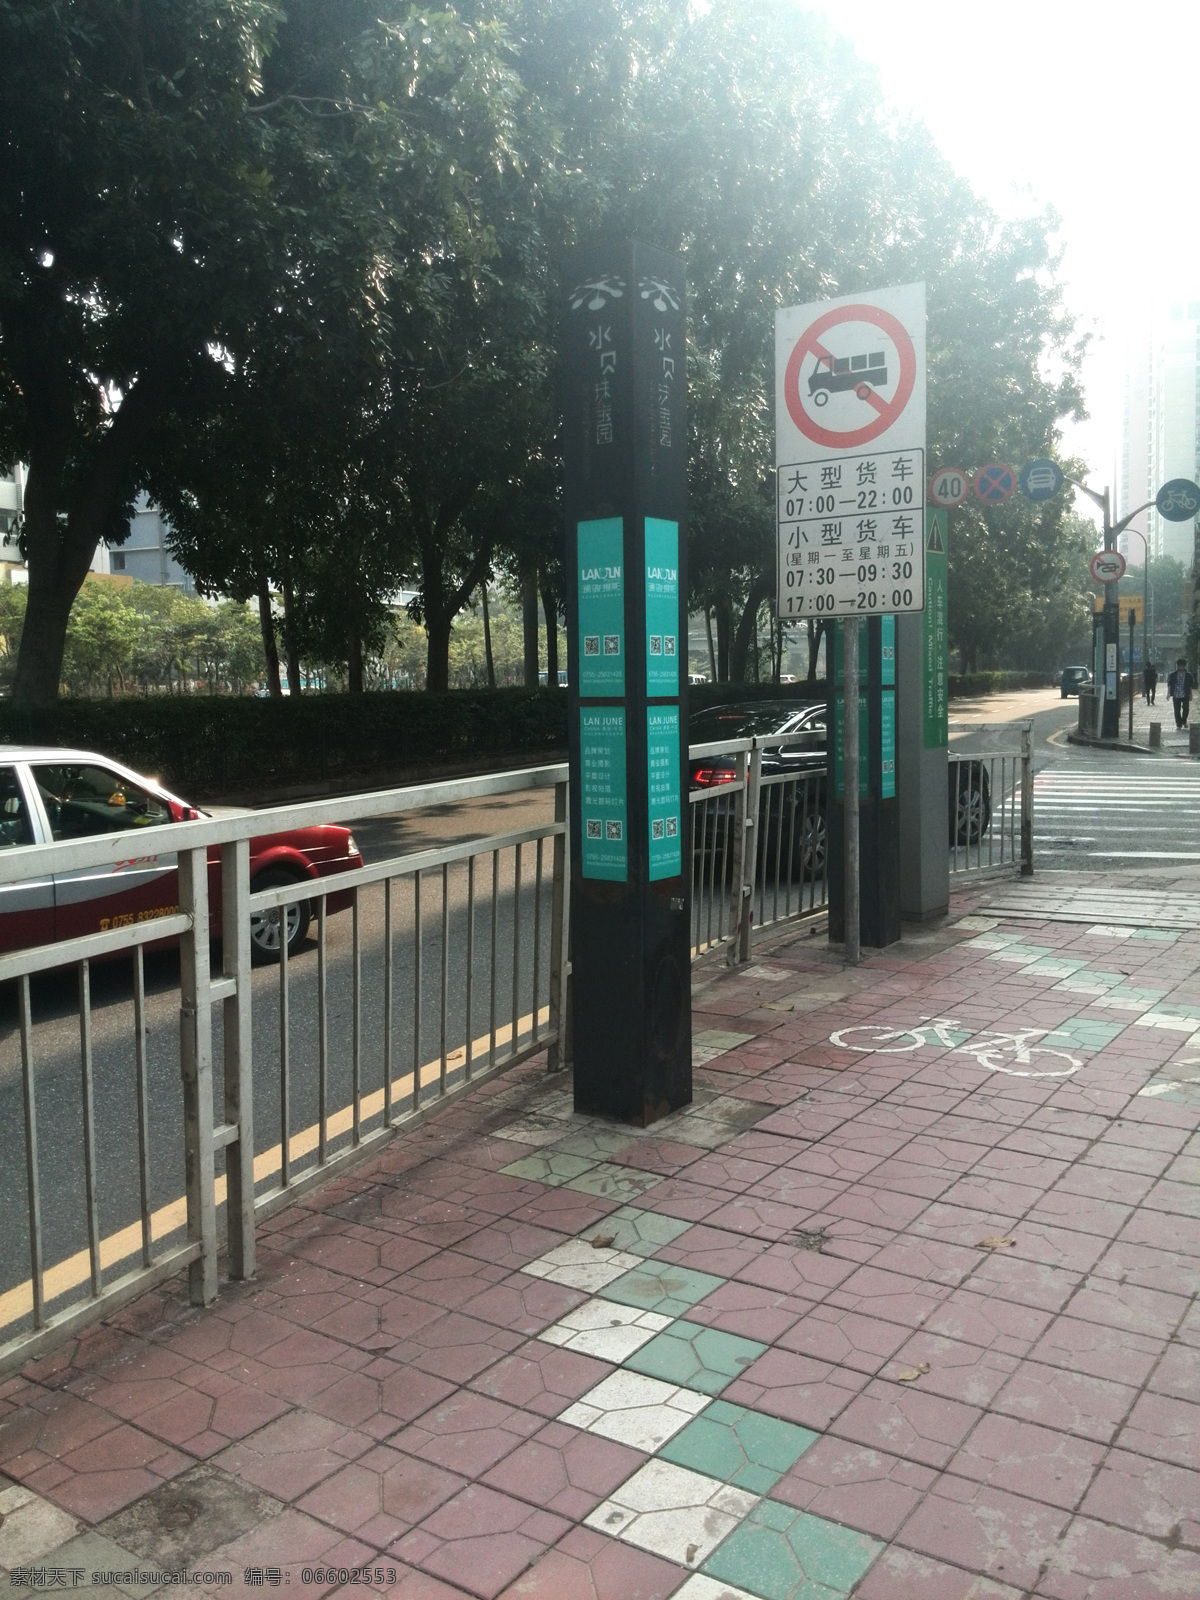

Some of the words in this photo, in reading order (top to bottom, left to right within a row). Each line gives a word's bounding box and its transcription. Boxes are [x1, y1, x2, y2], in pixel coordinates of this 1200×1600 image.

[787, 457, 914, 494] 大型货车
[938, 478, 961, 498] 40
[788, 515, 914, 549] 小型货车
[583, 717, 600, 725] LAN
[602, 717, 623, 725] JUNE
[649, 717, 662, 725] LAN
[663, 715, 678, 724] JUNE
[112, 914, 134, 929] 0755
